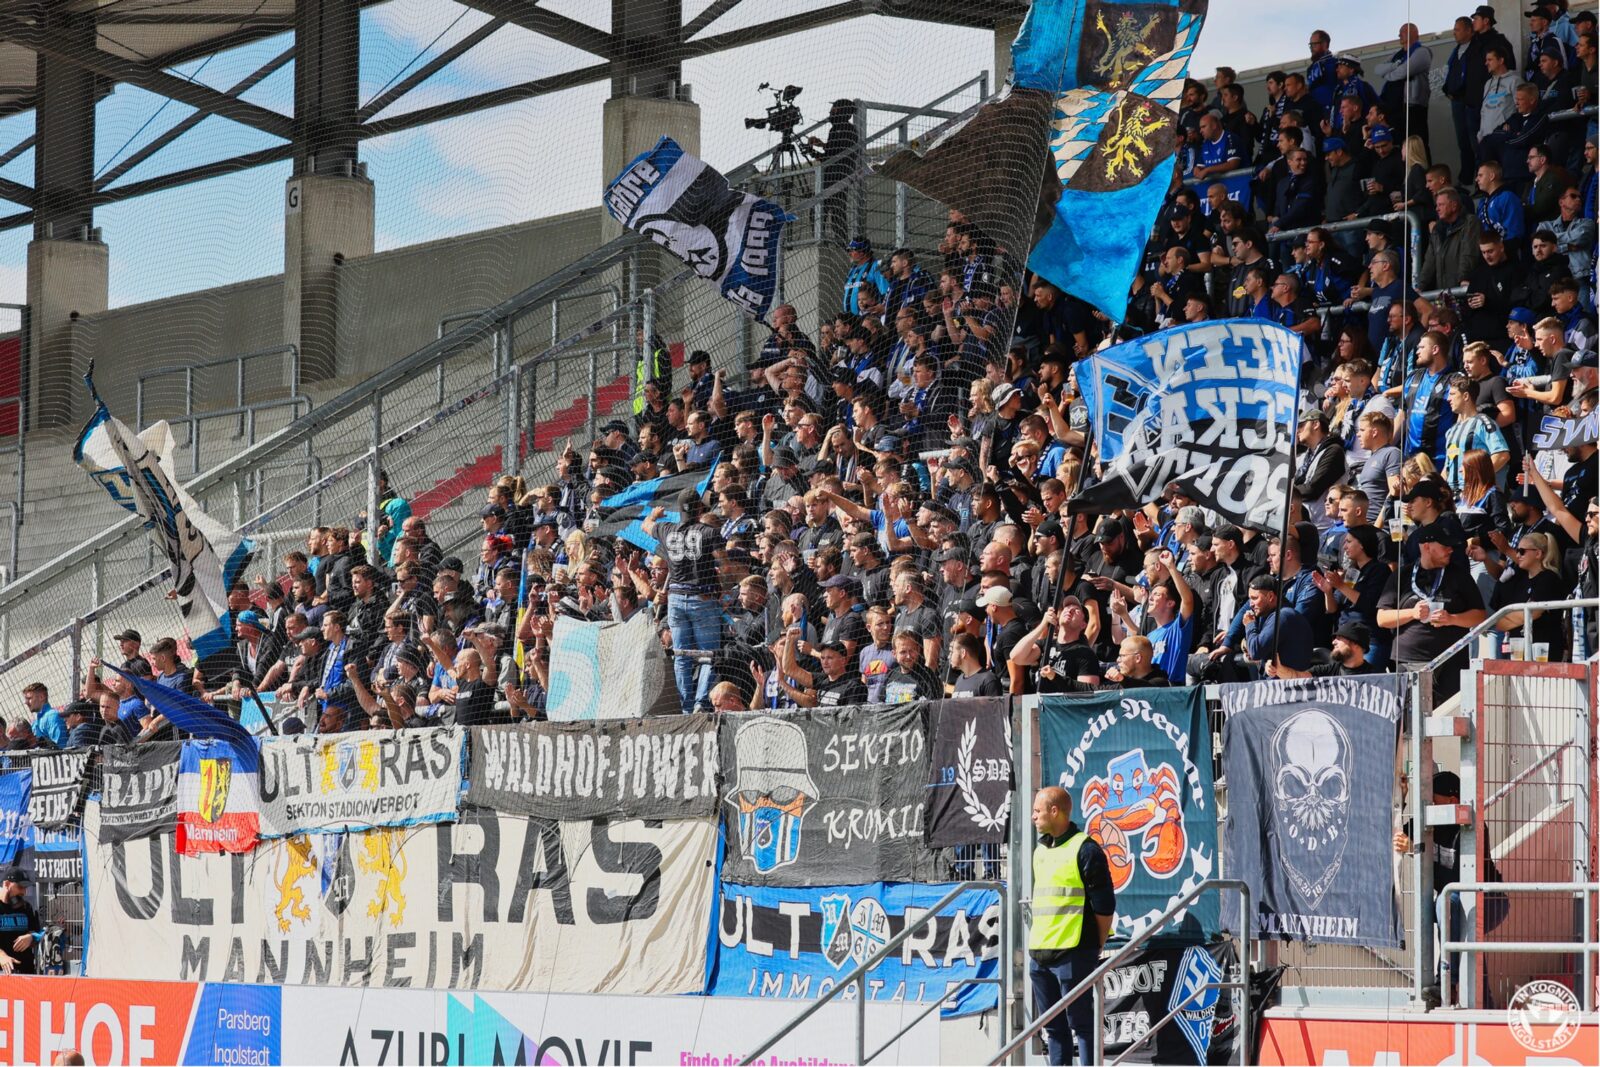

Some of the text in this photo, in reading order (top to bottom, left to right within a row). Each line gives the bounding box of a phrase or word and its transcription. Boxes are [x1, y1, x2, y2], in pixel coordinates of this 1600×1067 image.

[288, 186, 298, 208] G
[1253, 677, 1311, 708] DIRTY
[1313, 676, 1404, 724] BASTARDS
[482, 727, 720, 800] WALDHOF-POWER
[823, 728, 925, 776] SEKTIO
[328, 792, 420, 819] STADIONVERBOT
[1259, 912, 1359, 939] MANNHEIM
[180, 931, 485, 989] MANNHEIM
[218, 1008, 271, 1036] Parsberg
[214, 1042, 271, 1066] Ingolstadt
